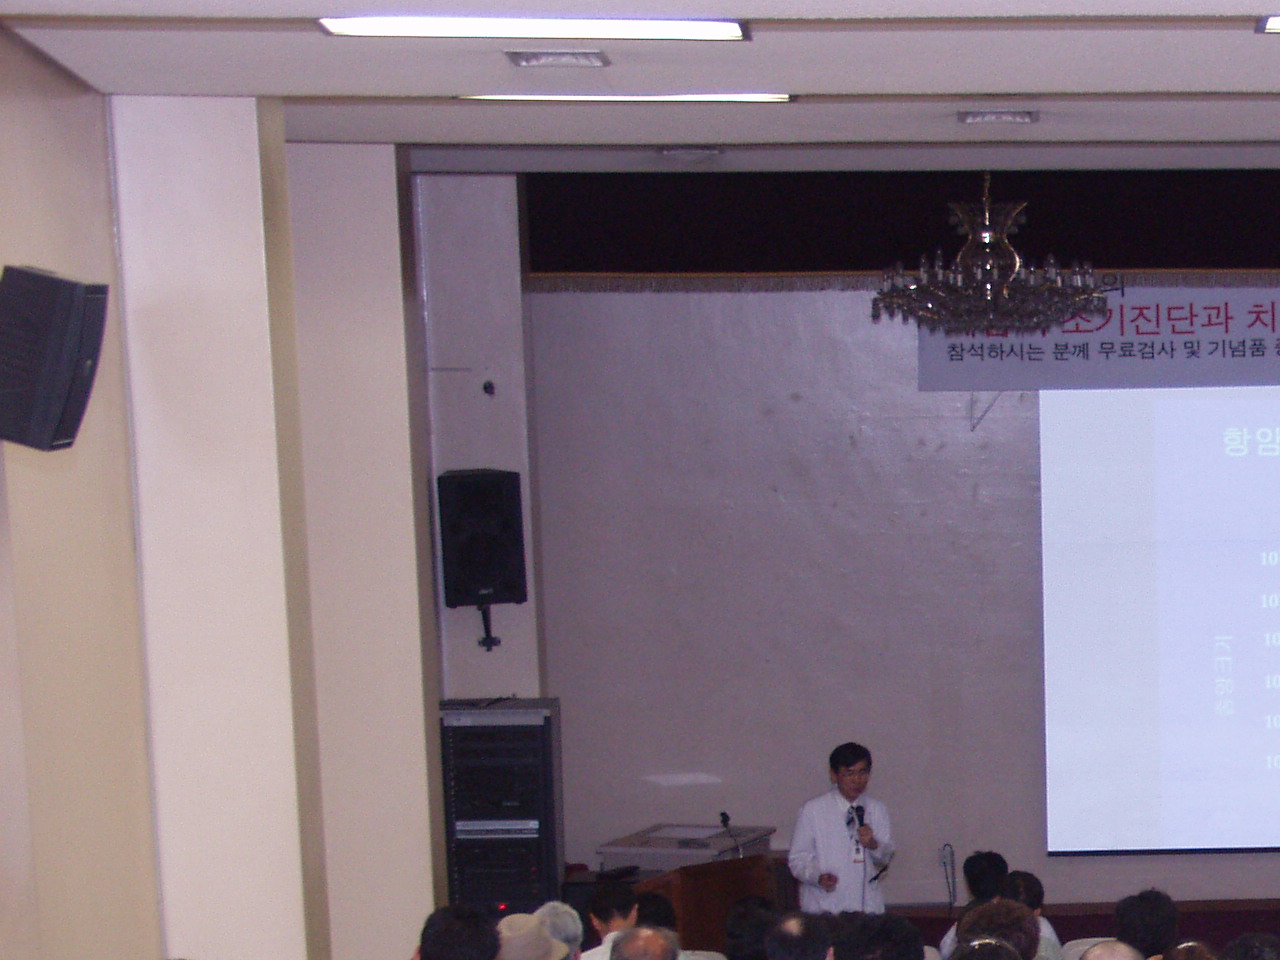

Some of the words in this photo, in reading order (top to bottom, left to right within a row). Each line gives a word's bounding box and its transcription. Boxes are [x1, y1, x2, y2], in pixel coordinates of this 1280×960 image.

[947, 342, 1045, 362] 참석하시는
[1052, 342, 1090, 361] 분께
[1099, 340, 1177, 361] 무료검사
[1183, 340, 1201, 359] 및
[1208, 338, 1268, 359] 기념품
